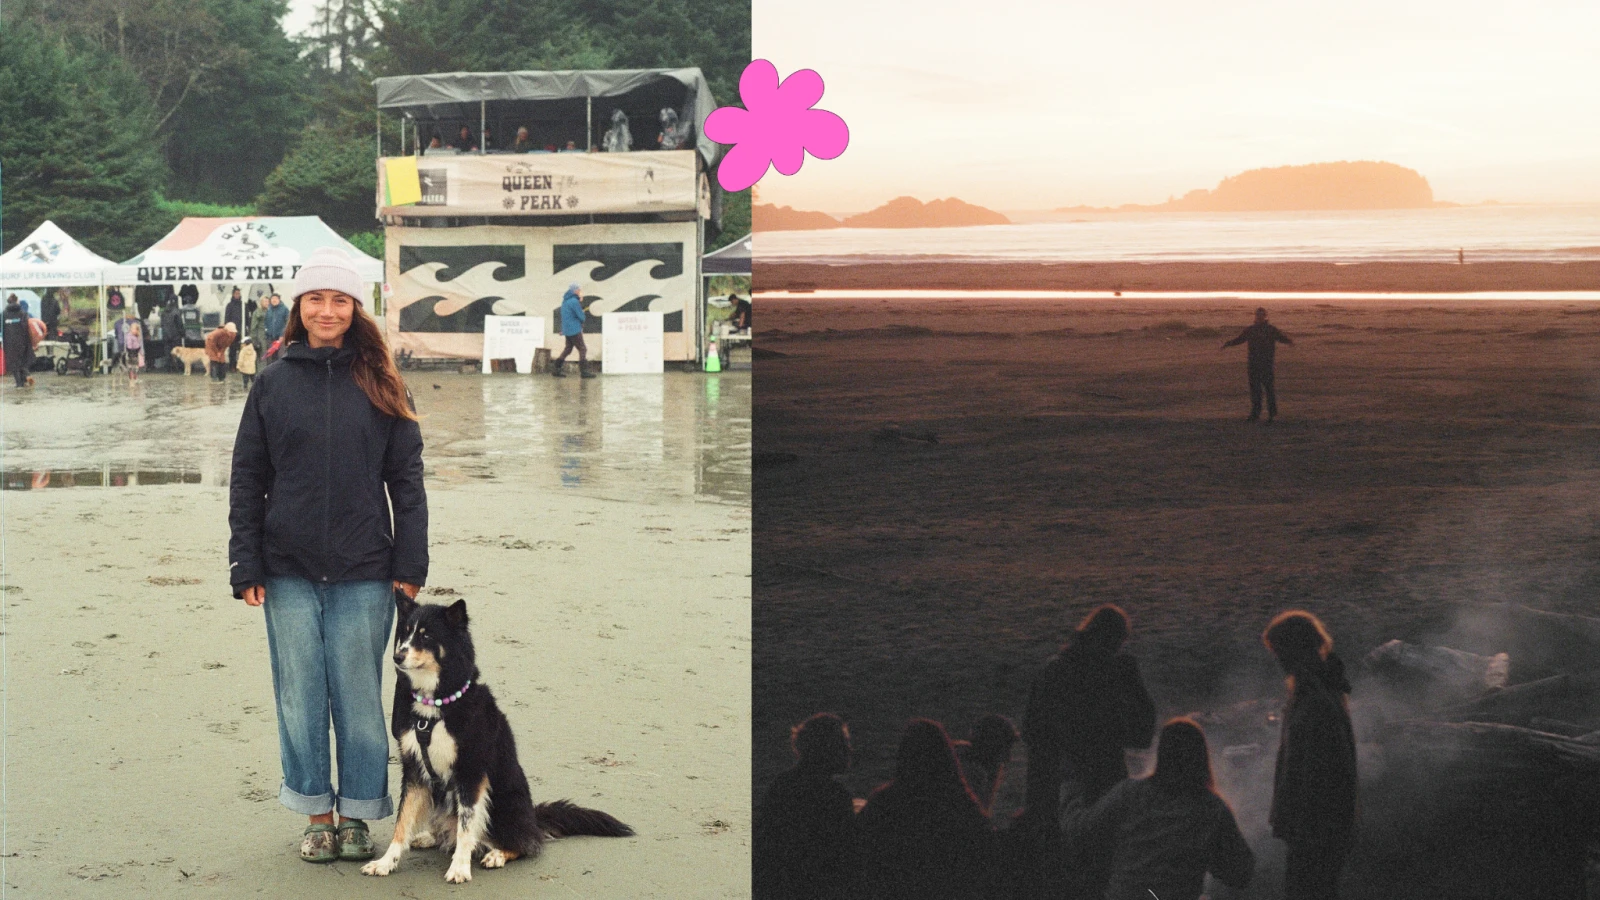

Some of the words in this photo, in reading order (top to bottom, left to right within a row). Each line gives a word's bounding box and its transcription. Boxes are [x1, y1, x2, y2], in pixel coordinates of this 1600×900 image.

[502, 175, 553, 192] QUEEN
[422, 194, 445, 203] ELTER
[520, 195, 562, 210] PEAK
[221, 222, 277, 240] QUEEN
[23, 271, 71, 279] LIFESAVING
[73, 271, 96, 279] CLUB
[137, 266, 204, 283] QUEEN
[211, 266, 237, 281] OF
[243, 265, 284, 280] THE
